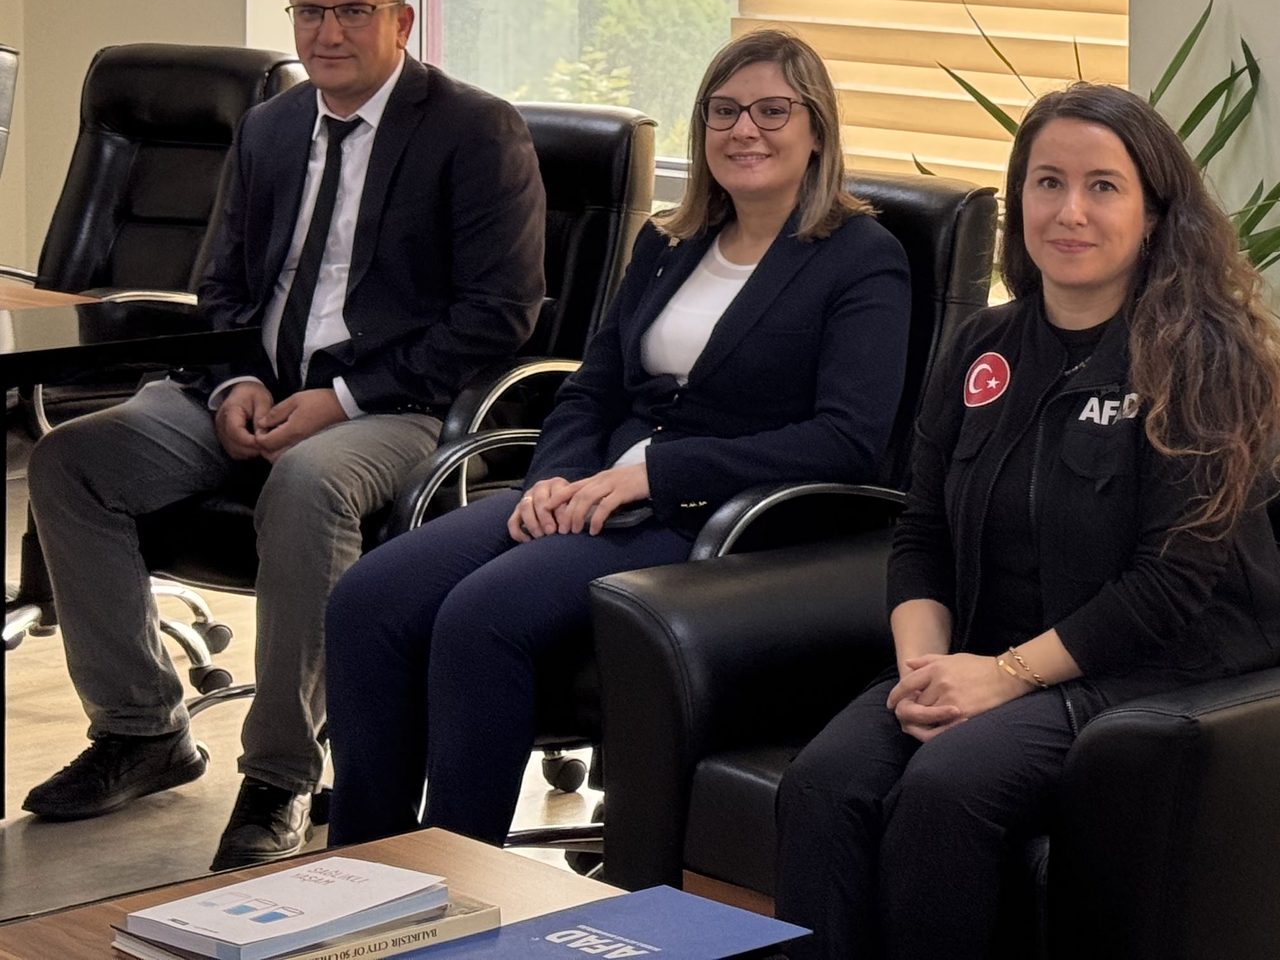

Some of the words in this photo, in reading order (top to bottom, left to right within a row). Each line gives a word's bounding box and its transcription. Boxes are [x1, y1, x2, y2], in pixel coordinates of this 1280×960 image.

[1078, 392, 1140, 426] AFD
[368, 941, 389, 954] CITY
[391, 928, 438, 948] BALIKESİR
[545, 929, 652, 960] AFAD
[351, 946, 366, 958] OF
